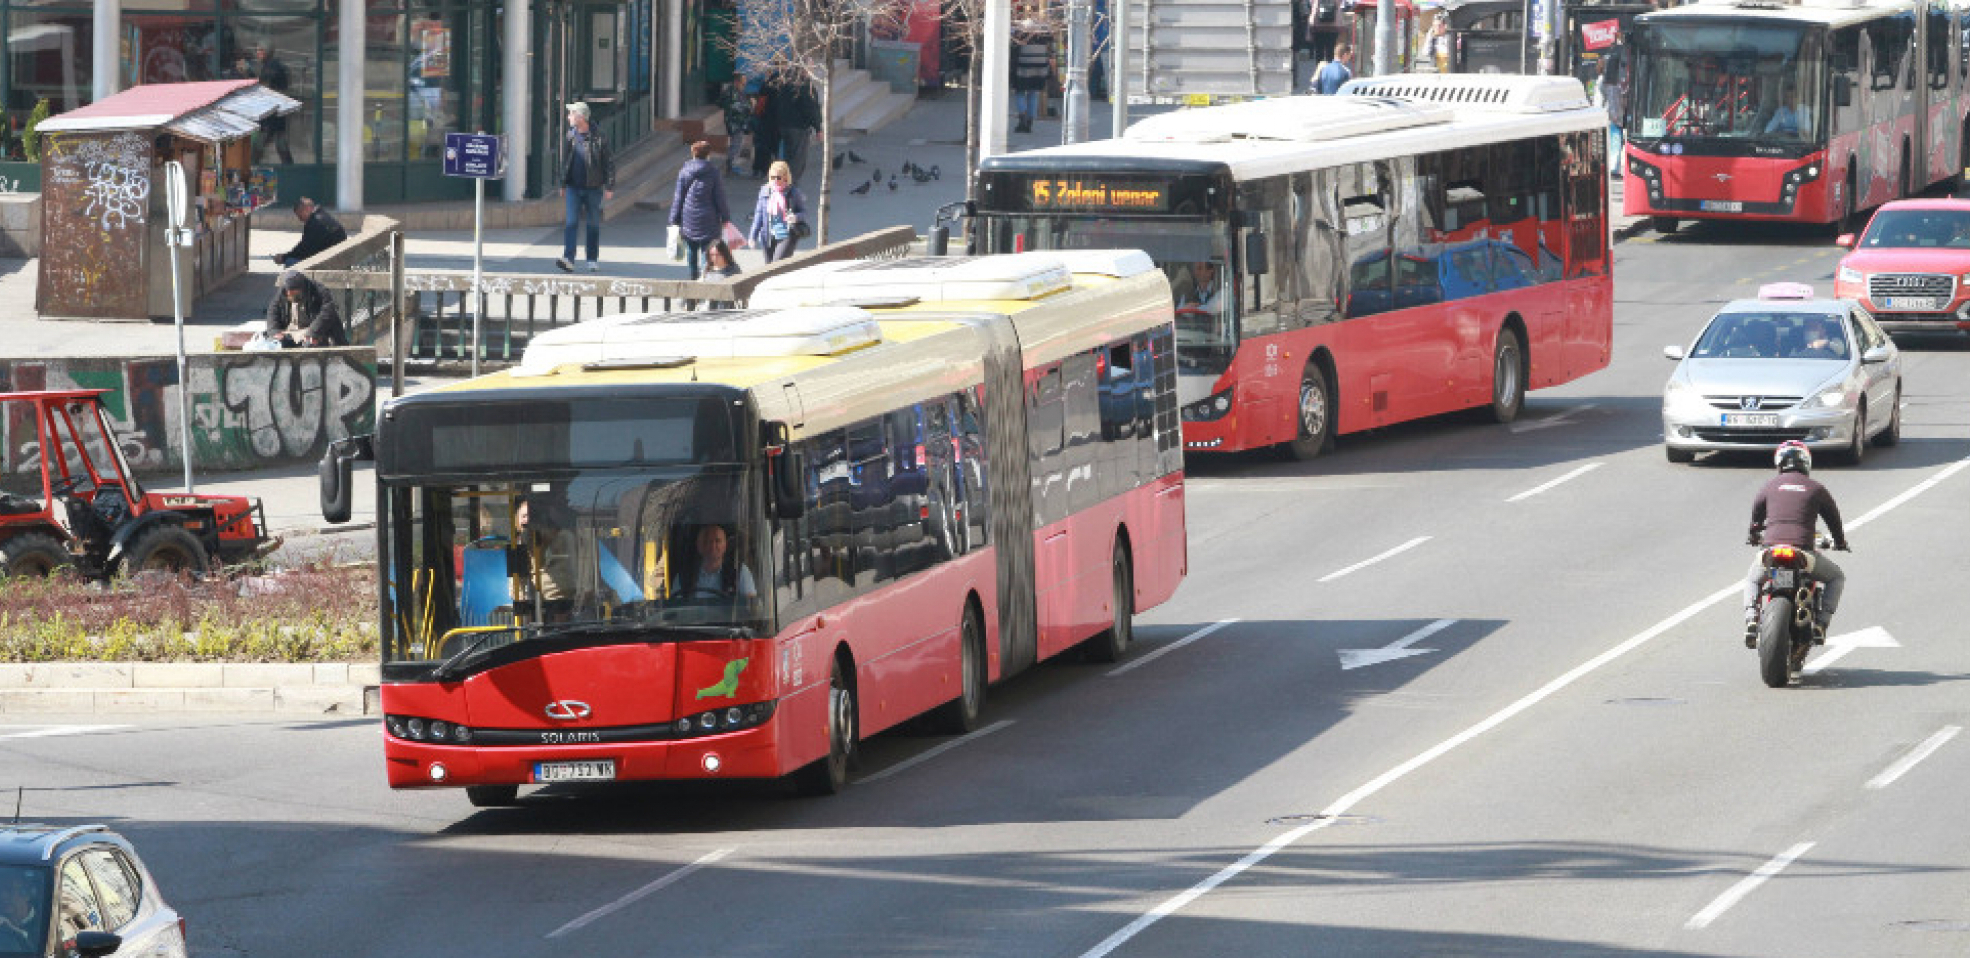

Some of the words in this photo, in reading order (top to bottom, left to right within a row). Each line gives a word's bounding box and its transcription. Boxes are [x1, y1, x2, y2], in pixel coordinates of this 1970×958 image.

[1033, 180, 1050, 206] 15
[1057, 181, 1106, 205] Zeleni
[541, 731, 600, 744] SOLARIS
